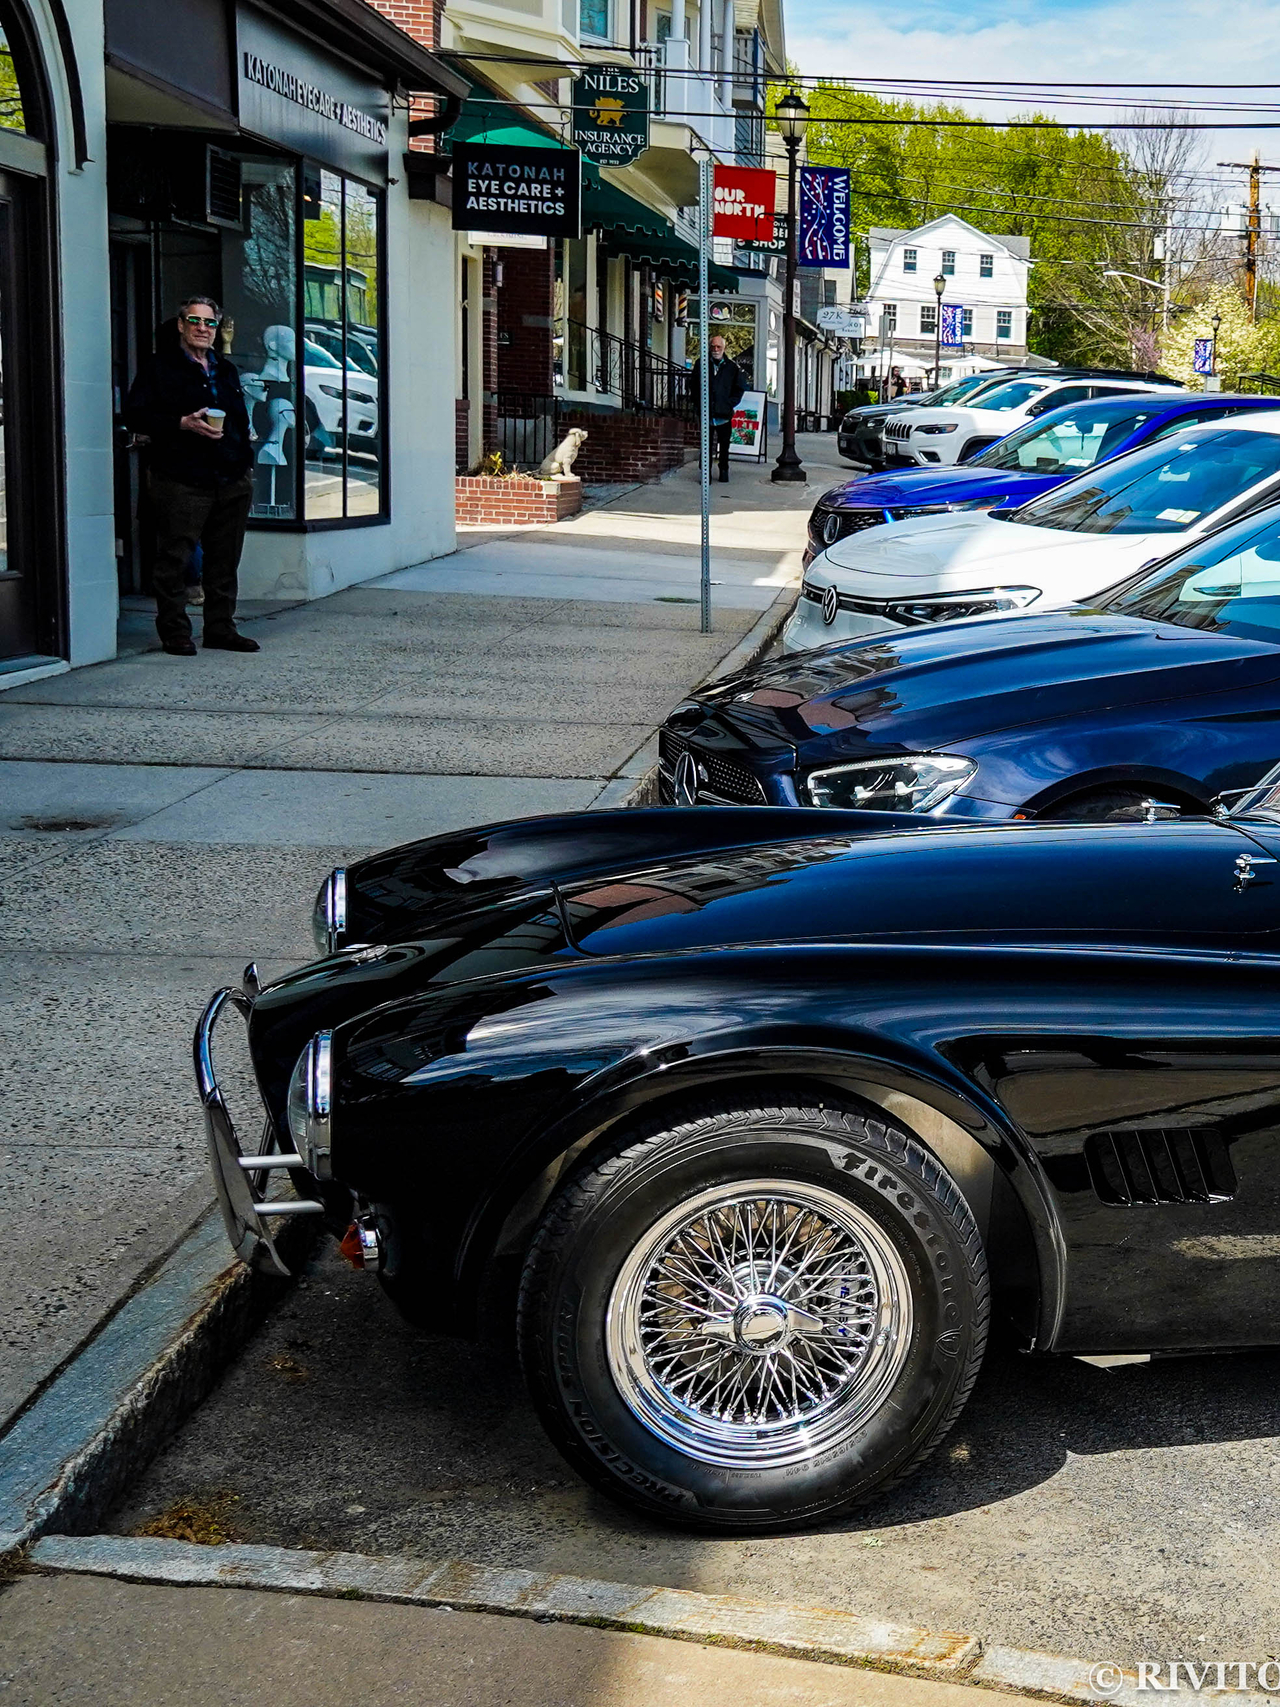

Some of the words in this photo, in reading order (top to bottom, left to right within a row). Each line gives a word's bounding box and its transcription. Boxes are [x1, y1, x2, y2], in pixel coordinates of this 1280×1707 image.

[583, 74, 640, 94] NILES
[244, 52, 298, 101] KATONAH
[340, 103, 387, 146] AESTHETICS
[574, 129, 646, 146] INSURANCE
[584, 142, 635, 156] AGENCY
[467, 161, 565, 181] KATONAH
[467, 178, 500, 194] EYE
[503, 181, 552, 197] CARE
[554, 187, 565, 197] +
[714, 186, 746, 203] OUR
[466, 196, 565, 216] AESTHETICS
[714, 200, 766, 219] NORTH
[832, 175, 849, 261] WELCOME
[752, 238, 786, 250] SHOP
[837, 1152, 961, 1324] Firestone
